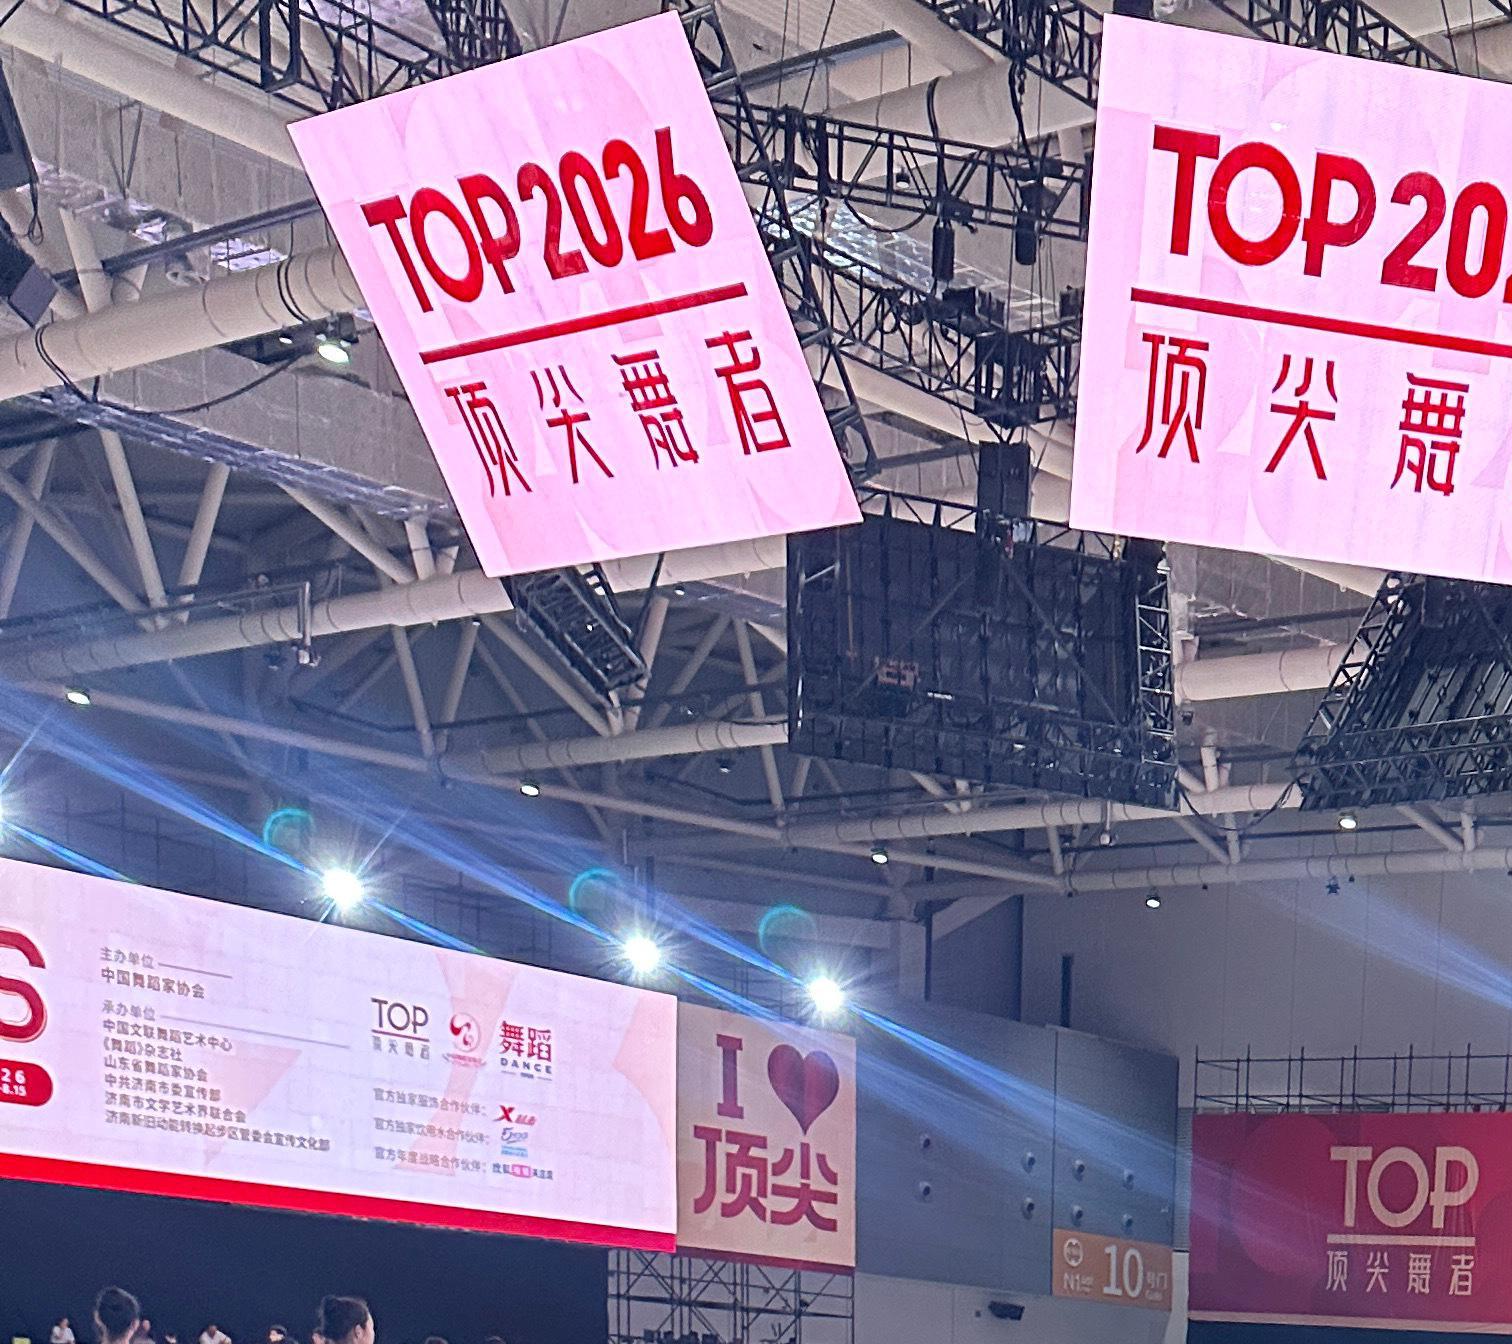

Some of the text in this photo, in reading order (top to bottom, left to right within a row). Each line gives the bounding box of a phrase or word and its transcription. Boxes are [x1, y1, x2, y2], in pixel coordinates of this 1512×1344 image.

[445, 331, 792, 497] 顶尖舞者
[100, 946, 155, 969] 主办单位
[101, 967, 205, 999] 中国舞蹈家协会
[102, 1000, 156, 1021] 承办单位
[371, 997, 428, 1033] TOP
[499, 1020, 552, 1062] 舞蹈
[500, 1057, 552, 1074] DANCE
[716, 1034, 743, 1119] I
[693, 1125, 839, 1232] 顶尖
[1330, 1145, 1481, 1229] TOP
[1103, 1245, 1144, 1298] 10
[1325, 1250, 1476, 1297] 顶尖舞者
